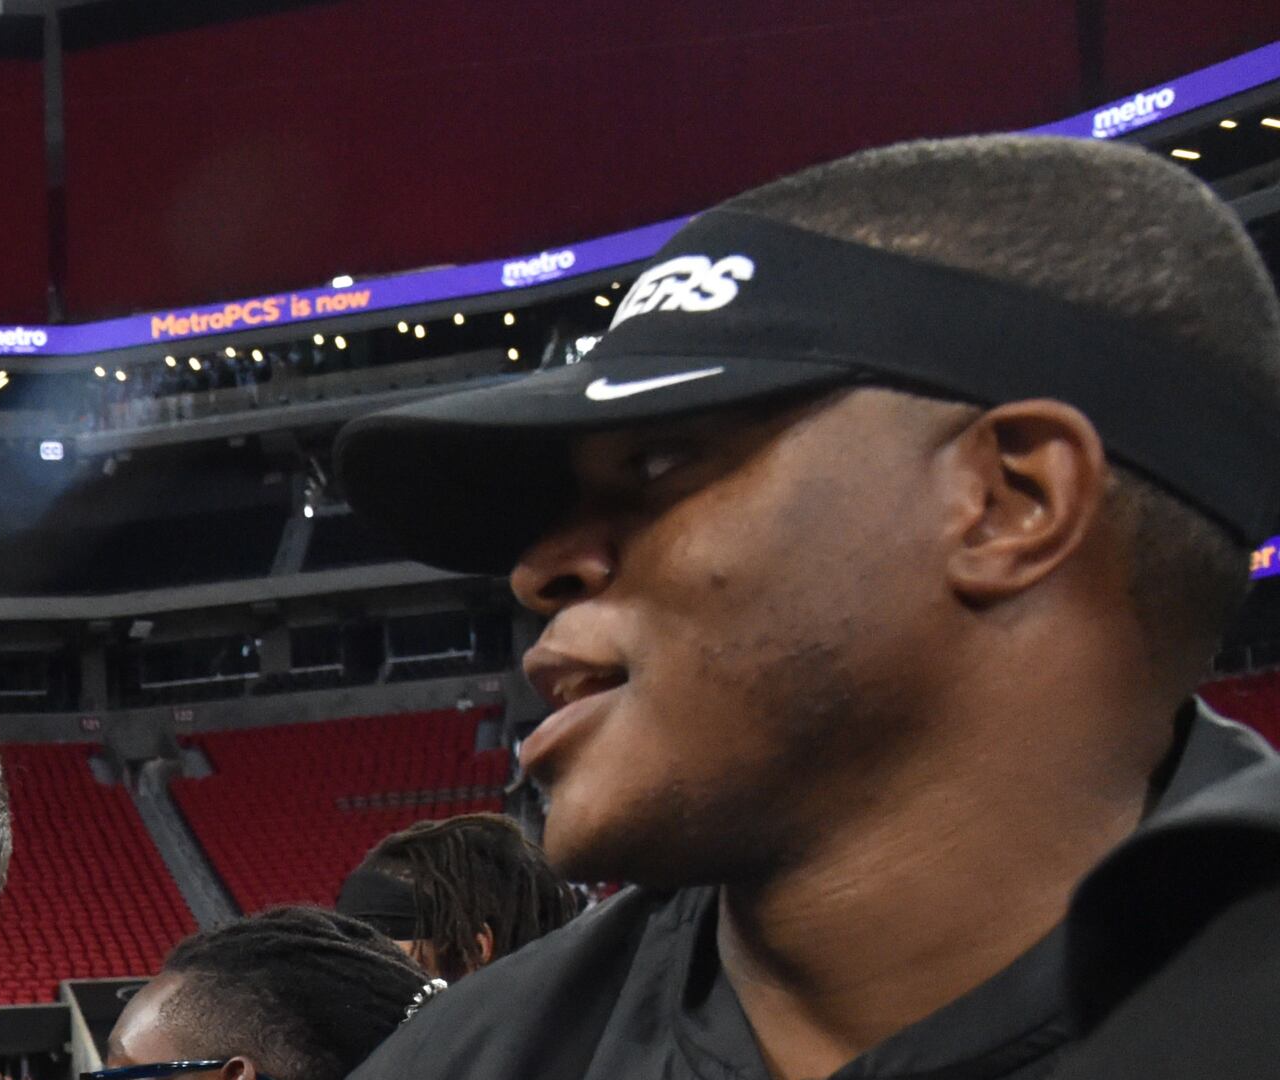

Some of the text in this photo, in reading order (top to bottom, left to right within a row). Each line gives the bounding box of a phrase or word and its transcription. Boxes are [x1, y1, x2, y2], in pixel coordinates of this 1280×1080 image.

[1093, 88, 1175, 128] metro
[502, 250, 576, 280] metro
[290, 294, 311, 318] is
[316, 290, 371, 314] now
